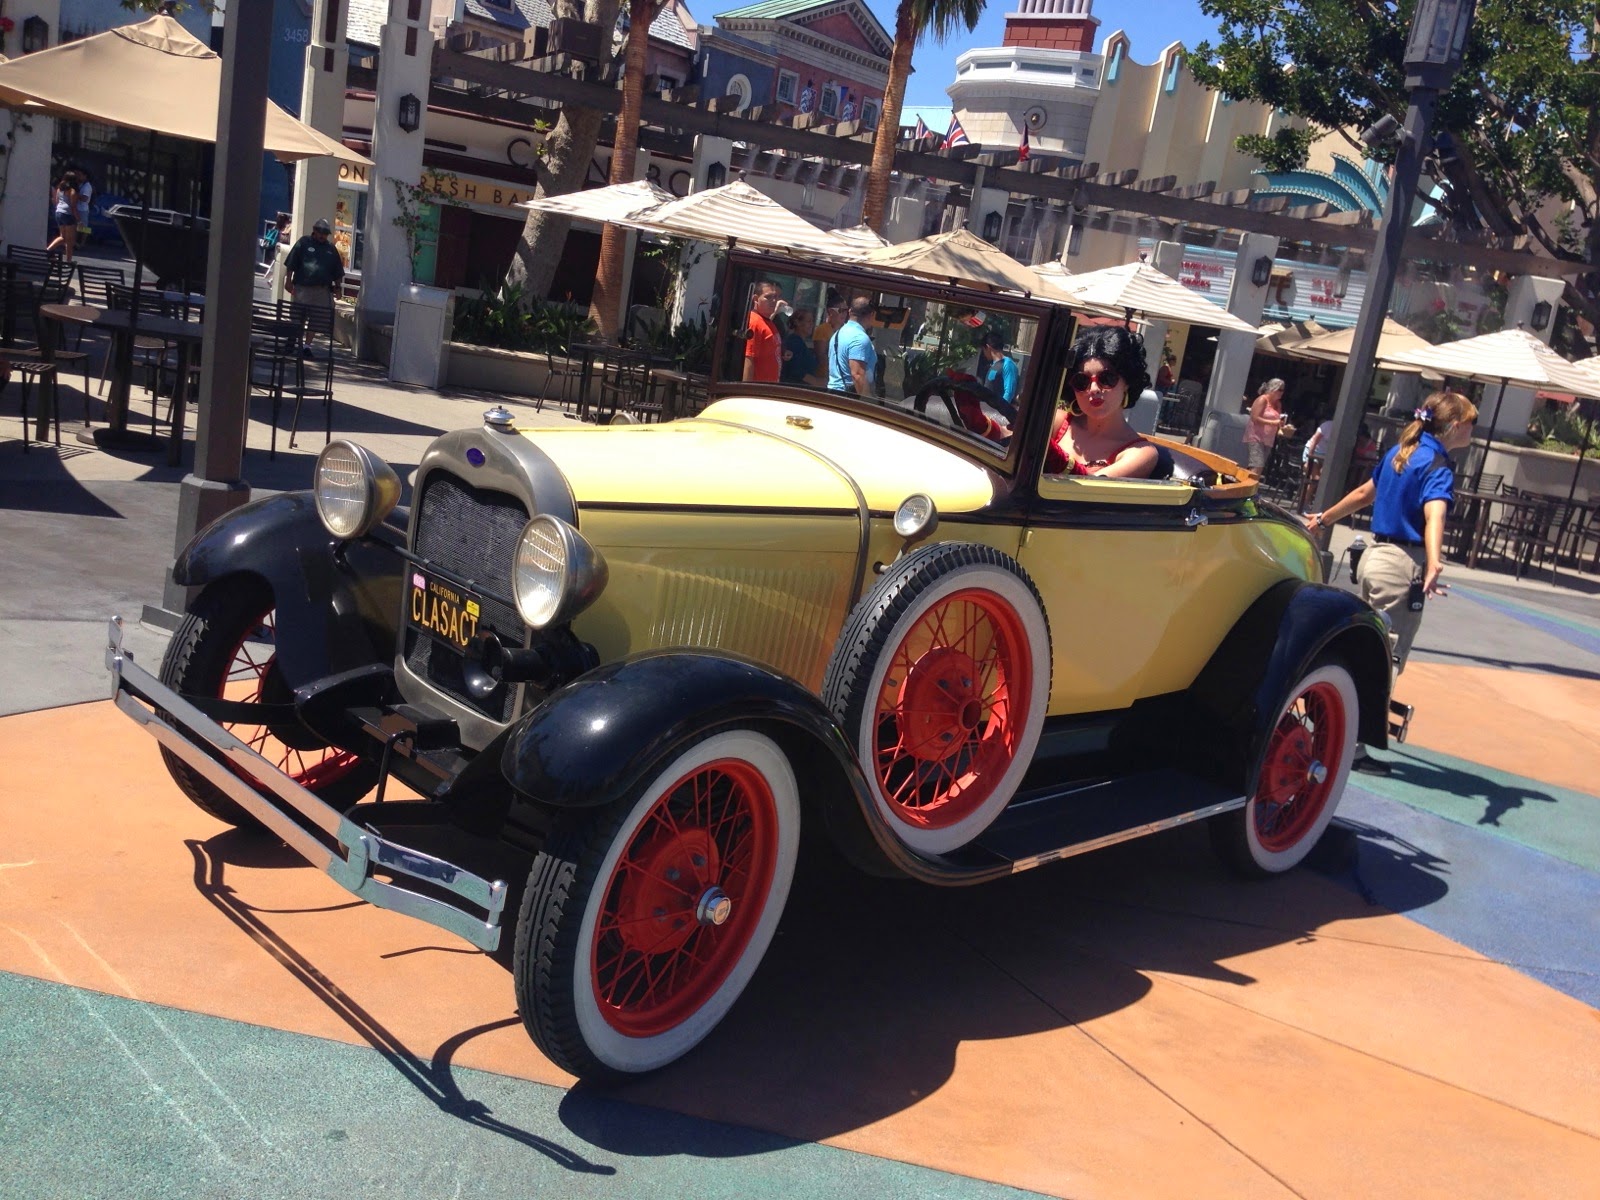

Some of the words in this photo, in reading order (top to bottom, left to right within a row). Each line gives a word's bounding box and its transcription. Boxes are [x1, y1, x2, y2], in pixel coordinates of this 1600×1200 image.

[284, 28, 309, 43] 3458
[420, 175, 477, 199] RESH
[430, 582, 460, 604] CALIFORNIA
[413, 587, 478, 646] CLASACT
